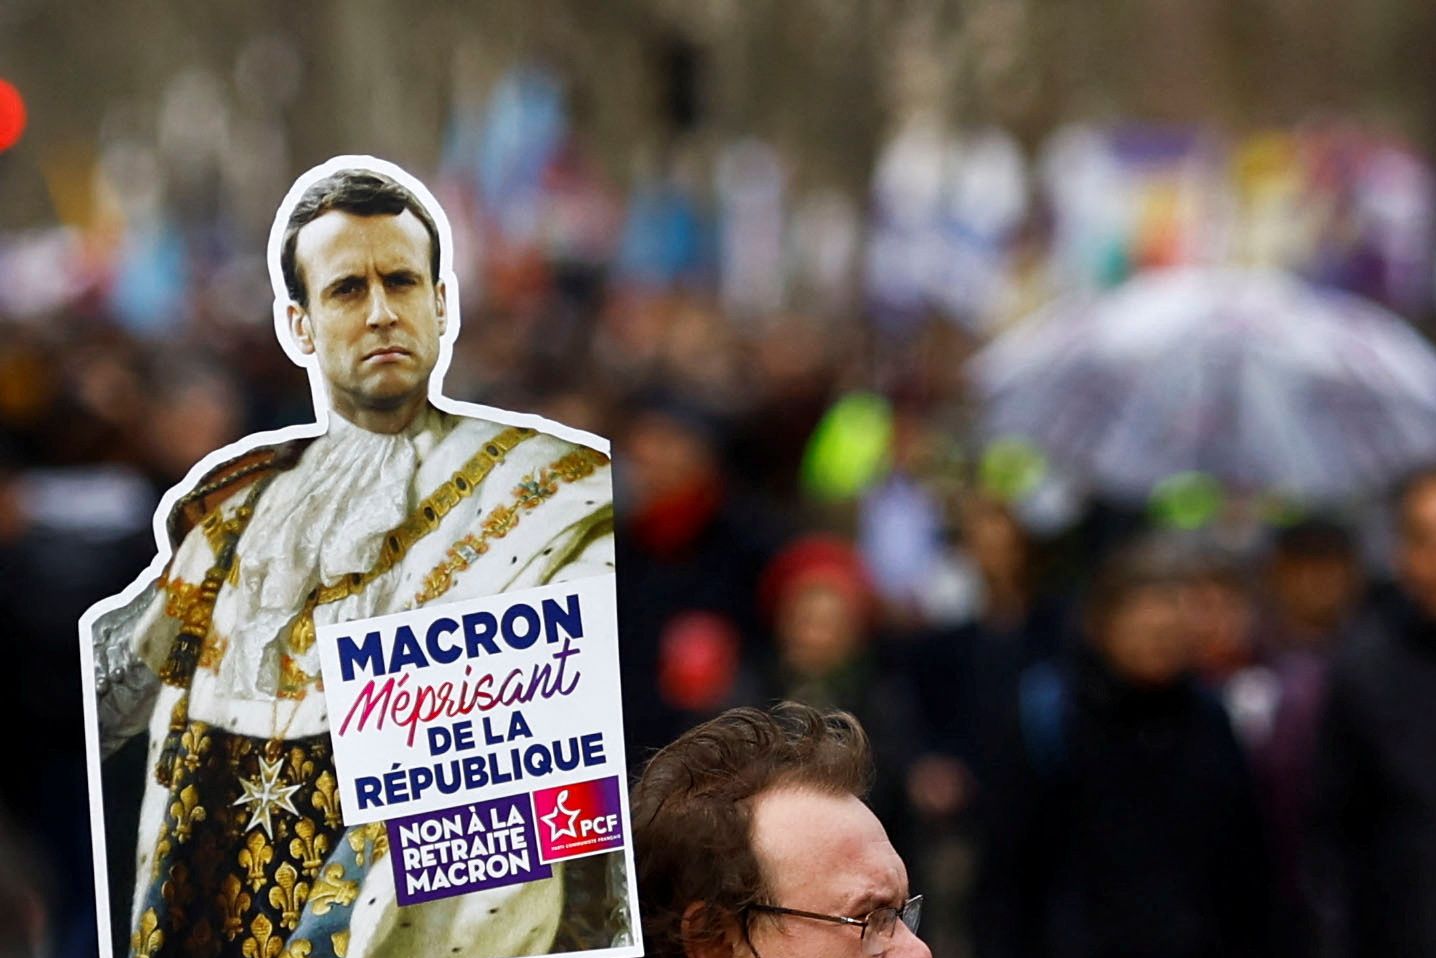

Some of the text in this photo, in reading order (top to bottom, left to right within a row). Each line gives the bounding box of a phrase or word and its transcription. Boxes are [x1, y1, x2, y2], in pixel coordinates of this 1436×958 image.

[337, 594, 584, 682] MACRON
[338, 637, 581, 748] Méprisant
[427, 710, 533, 756] DE LA
[354, 732, 607, 810] RÉPUBLIQUE
[399, 804, 525, 848] NON À LA
[403, 826, 527, 871] RETRAITE
[580, 814, 618, 837] PCF
[406, 849, 531, 896] MACRON
